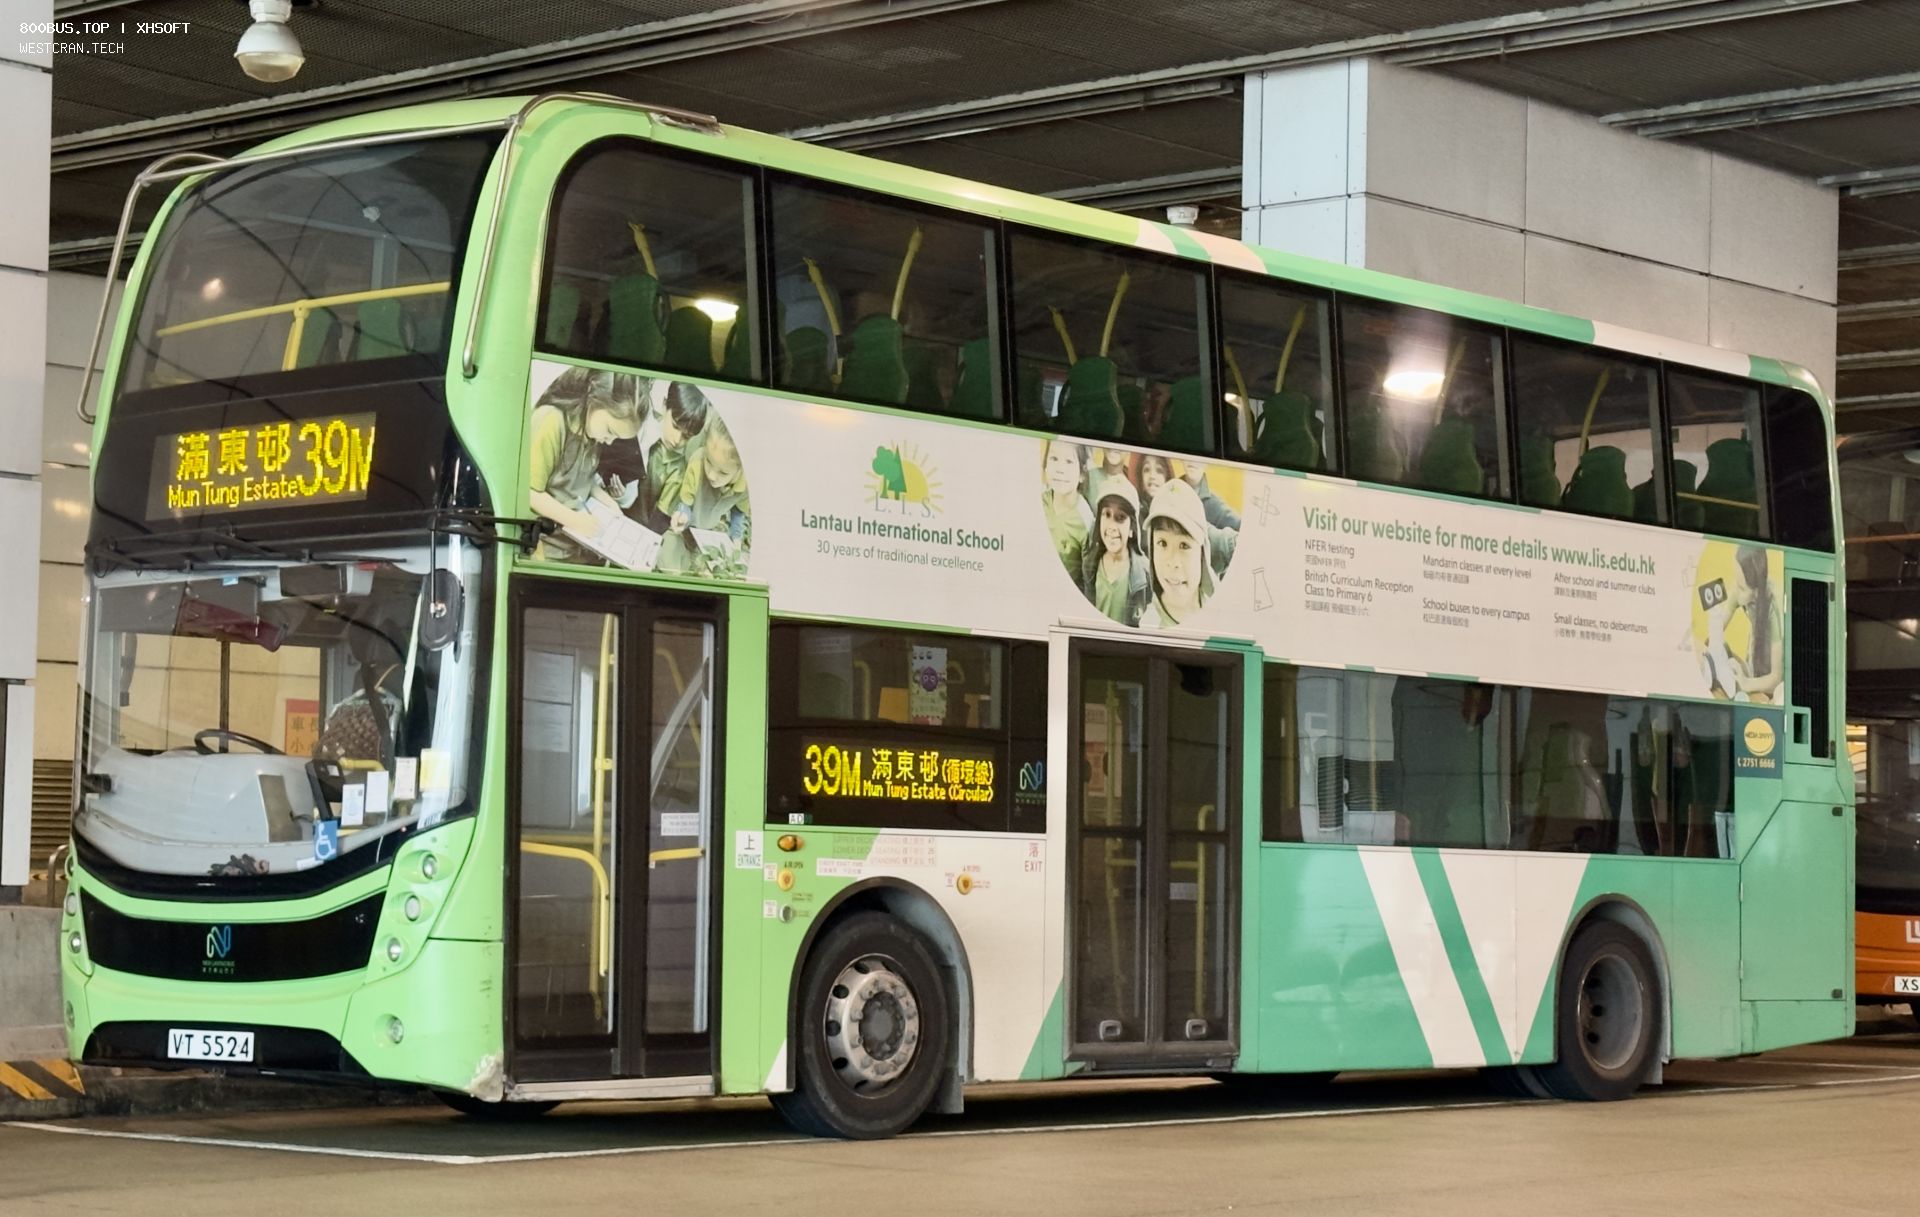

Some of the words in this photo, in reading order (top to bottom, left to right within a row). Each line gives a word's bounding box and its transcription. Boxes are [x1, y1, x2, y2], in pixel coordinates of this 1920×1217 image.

[176, 423, 292, 481] 滿東邨
[298, 419, 376, 496] 39M
[168, 484, 200, 510] Mun
[201, 480, 240, 508] Tung
[243, 474, 298, 502] Estate
[801, 509, 853, 533] Lantau
[857, 516, 953, 545] International
[956, 529, 1005, 552] School
[1303, 506, 1338, 532] Visit
[1341, 517, 1369, 536] our
[1372, 519, 1432, 545] website
[1435, 526, 1457, 548] for
[1460, 533, 1499, 554] more
[1502, 536, 1548, 561] details
[1551, 547, 1656, 576] www.lis.edu.hk
[816, 539, 831, 554] 30
[833, 543, 861, 559] years
[863, 546, 875, 559] of
[877, 548, 929, 566] traditional
[931, 556, 984, 572] excellence
[1305, 539, 1327, 552] NFER
[1328, 543, 1355, 559] testing
[1423, 554, 1458, 569] Mandarin
[1459, 560, 1484, 573] classes
[1485, 565, 1493, 574] at
[1493, 567, 1514, 579] every
[1515, 567, 1532, 579] level
[1305, 569, 1329, 583] British
[1330, 572, 1373, 589] Curriculum
[1375, 578, 1414, 594] Reception
[1305, 584, 1325, 597] Class
[1326, 586, 1335, 598] to
[1336, 587, 1367, 603] Primary
[1367, 591, 1373, 602] 6
[1554, 572, 1571, 584] After
[1572, 576, 1595, 587] school
[1596, 579, 1609, 589] and
[1611, 581, 1637, 593] summer
[1638, 583, 1656, 595] clubs
[1423, 597, 1449, 611] School
[1449, 601, 1471, 614] buses
[1472, 604, 1480, 615] to
[1481, 607, 1502, 620] every
[1502, 609, 1531, 623] campus
[1554, 612, 1573, 625] Small
[1600, 620, 1609, 629] no
[1610, 621, 1649, 634] debentures
[803, 744, 862, 797] 39M
[871, 748, 939, 783] 滿東邨
[1742, 757, 1758, 768] 2751
[863, 780, 884, 798] Mun
[885, 780, 909, 801] Tung
[911, 783, 946, 801] Estate
[743, 833, 756, 851] 上
[1024, 859, 1043, 873] EXIT
[1902, 978, 1919, 991] XS
[173, 1033, 195, 1056] VT
[202, 1034, 250, 1058] 5524
